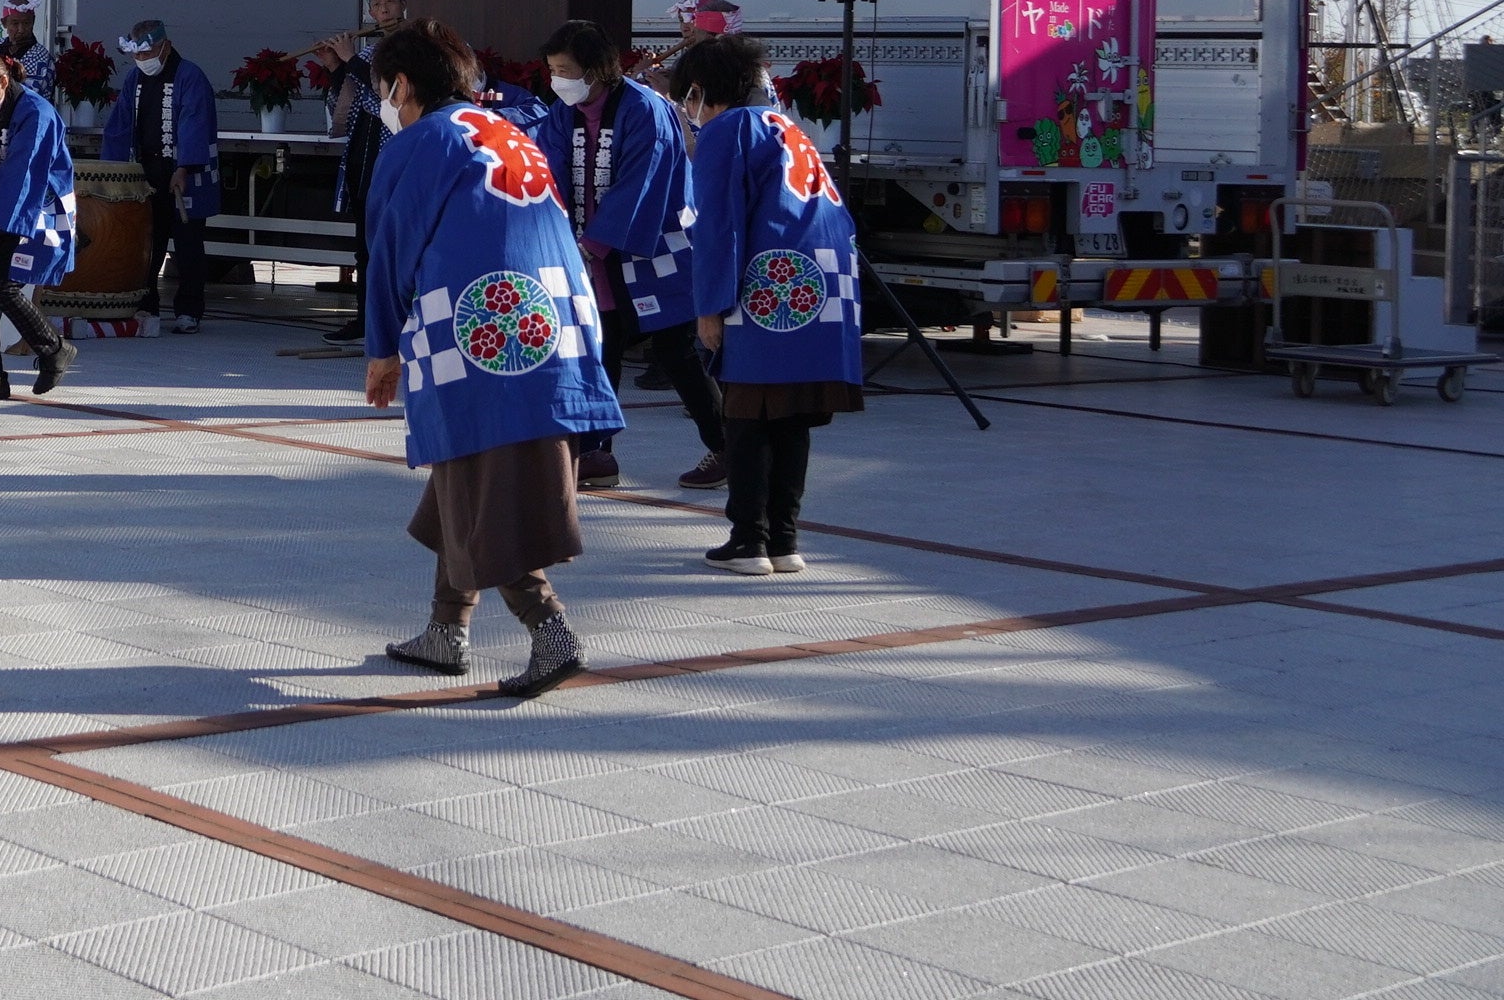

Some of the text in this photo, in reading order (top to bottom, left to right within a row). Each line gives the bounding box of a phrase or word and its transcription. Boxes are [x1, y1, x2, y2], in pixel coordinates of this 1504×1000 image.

[1049, 0, 1070, 13] Made
[1090, 184, 1106, 194] FU
[1090, 193, 1114, 204] CAR
